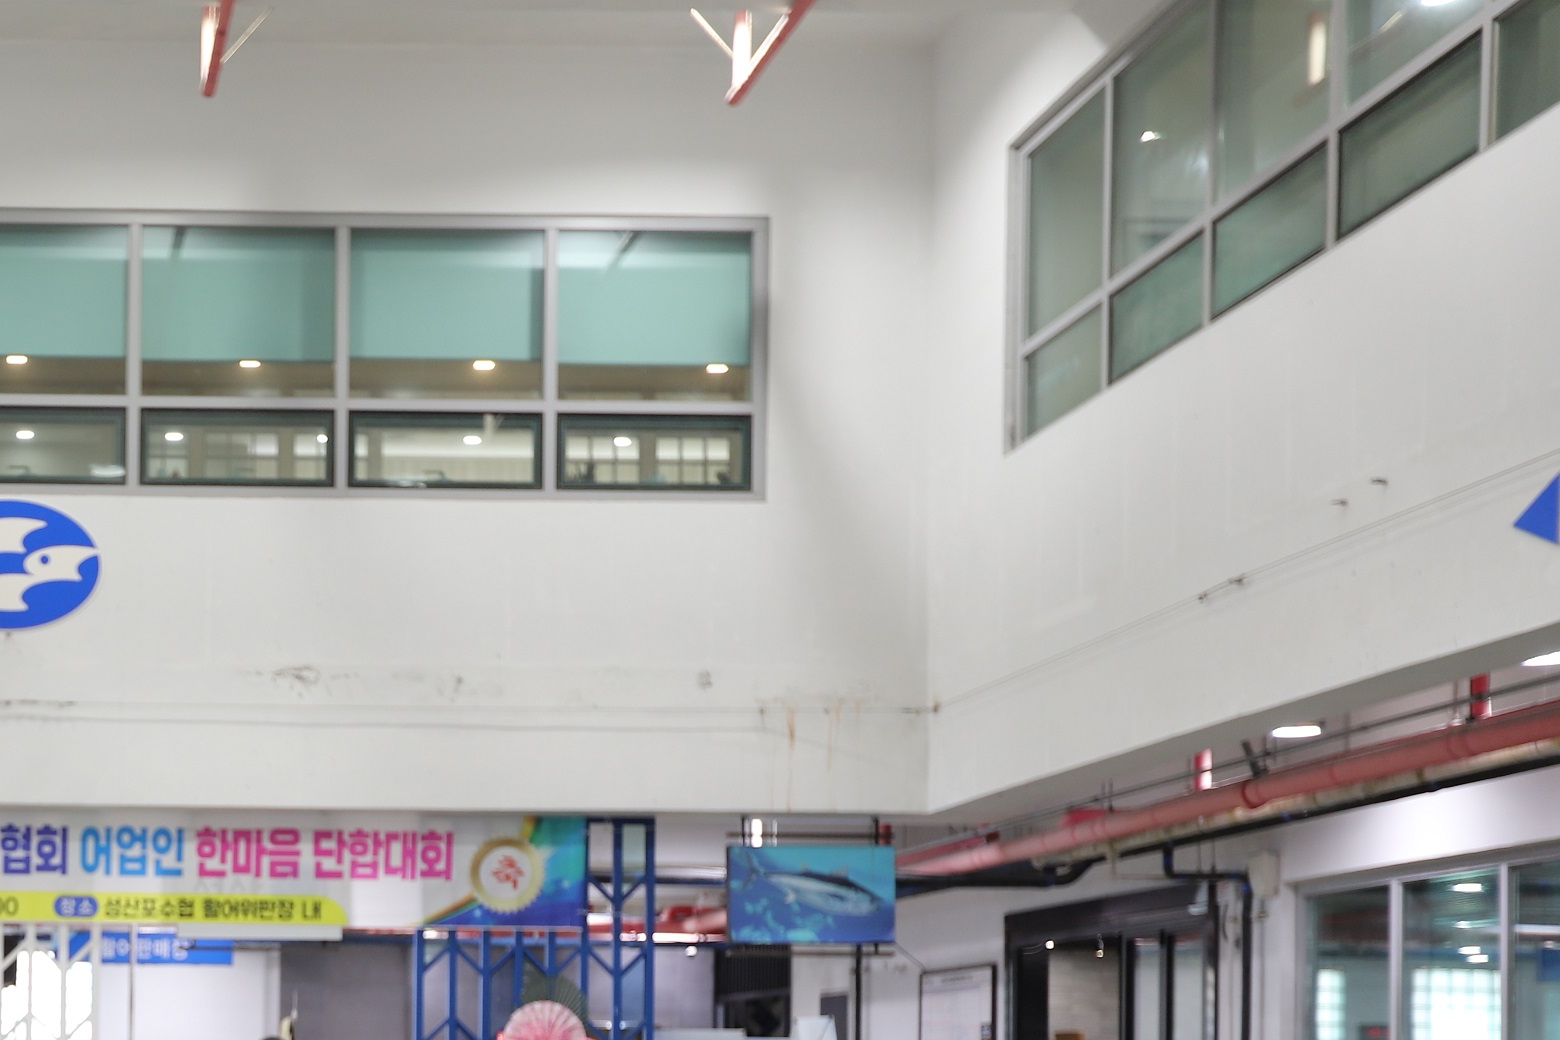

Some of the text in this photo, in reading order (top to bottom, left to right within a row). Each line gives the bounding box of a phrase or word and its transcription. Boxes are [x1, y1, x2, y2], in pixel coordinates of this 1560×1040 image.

[80, 825, 185, 876] 어업인
[196, 826, 302, 879] 한마음
[313, 828, 454, 881] 단합대회
[104, 898, 195, 919] 성산포수협
[302, 900, 323, 920] 내
